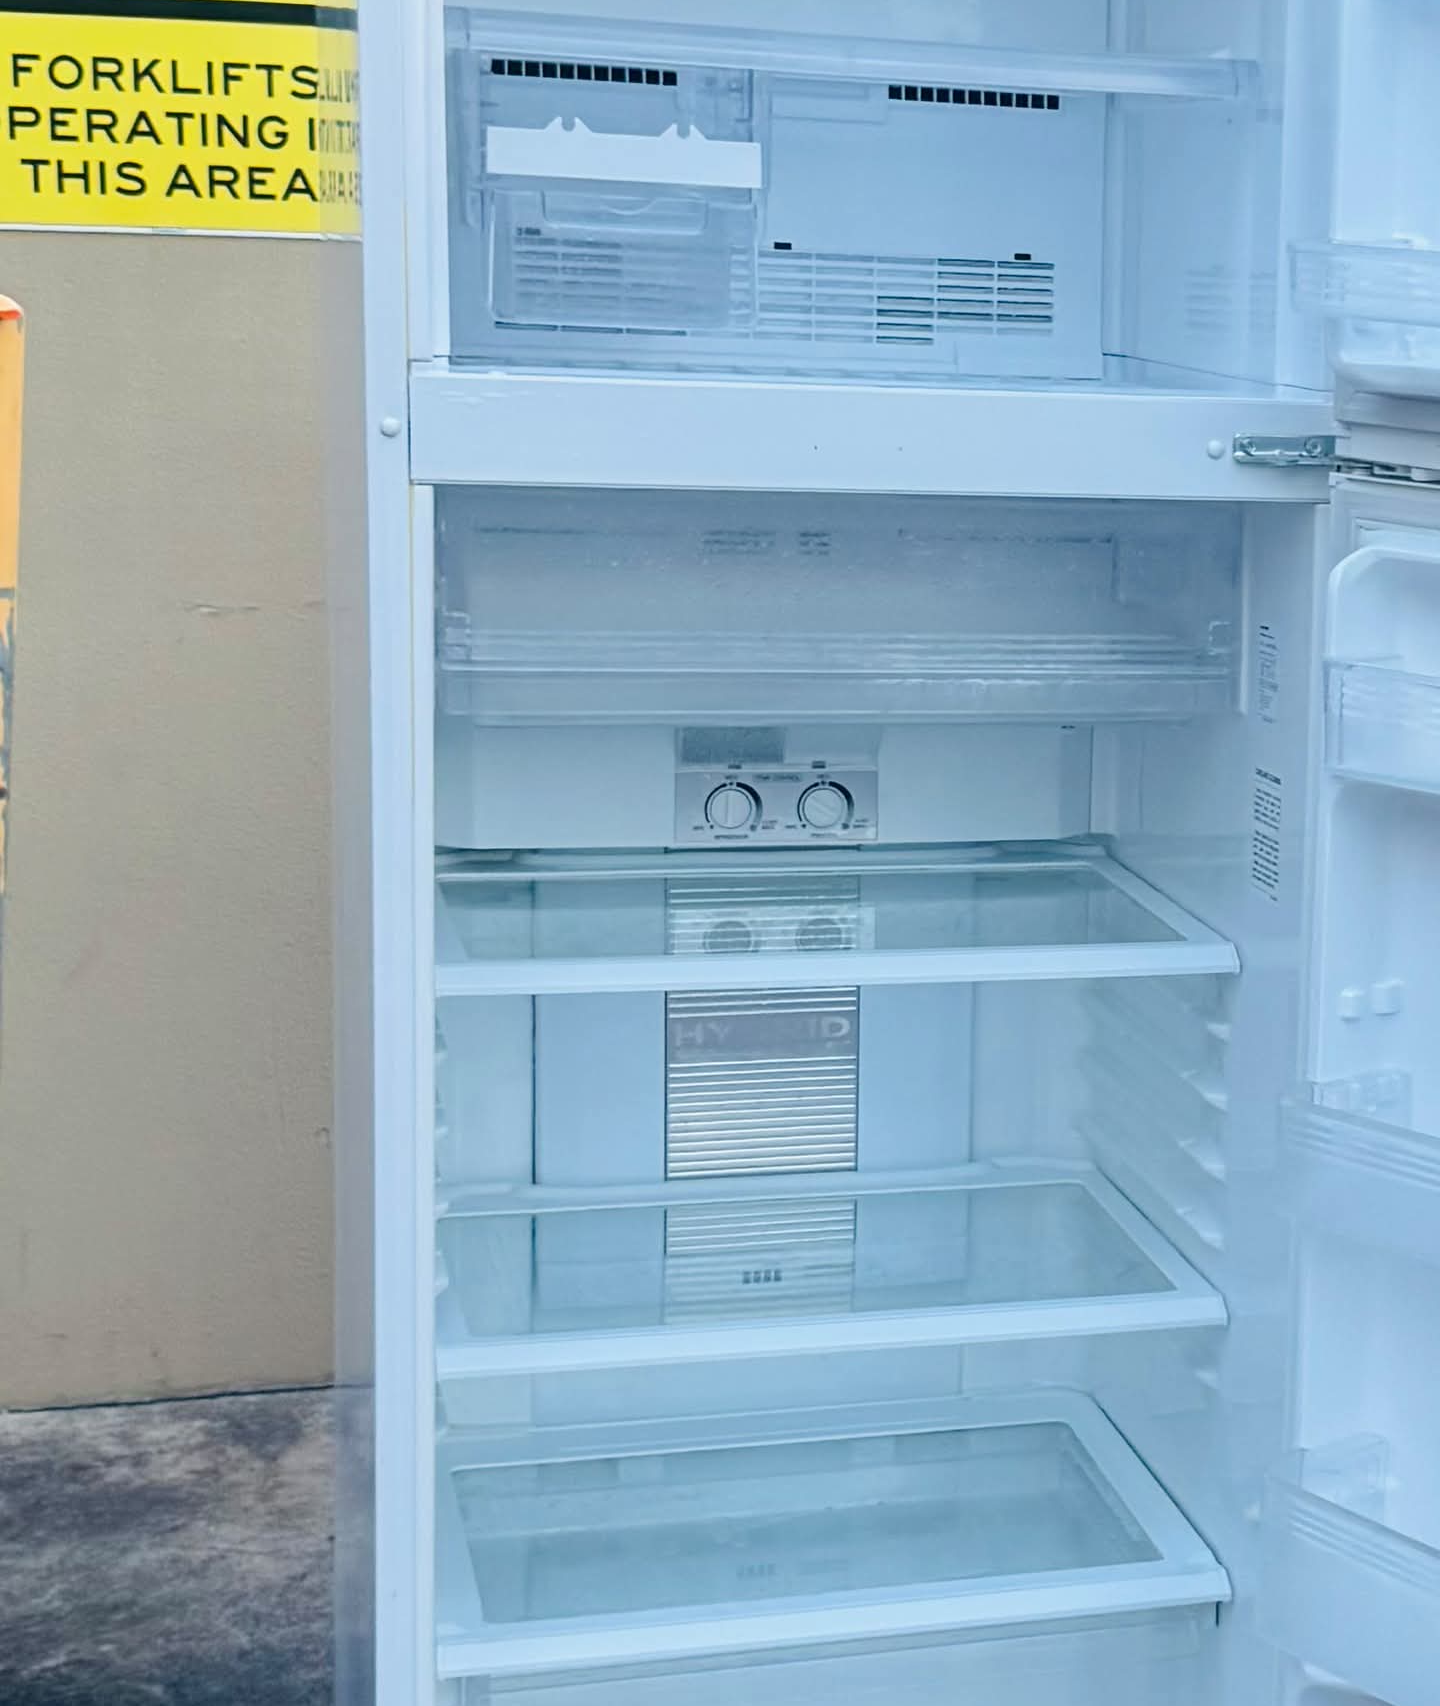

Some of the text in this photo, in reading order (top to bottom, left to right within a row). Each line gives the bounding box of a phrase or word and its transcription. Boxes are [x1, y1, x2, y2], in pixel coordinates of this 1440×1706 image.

[11, 53, 319, 100] FORKLIFTS
[0, 105, 316, 152] PERATING I
[20, 158, 319, 202] THIS AREA
